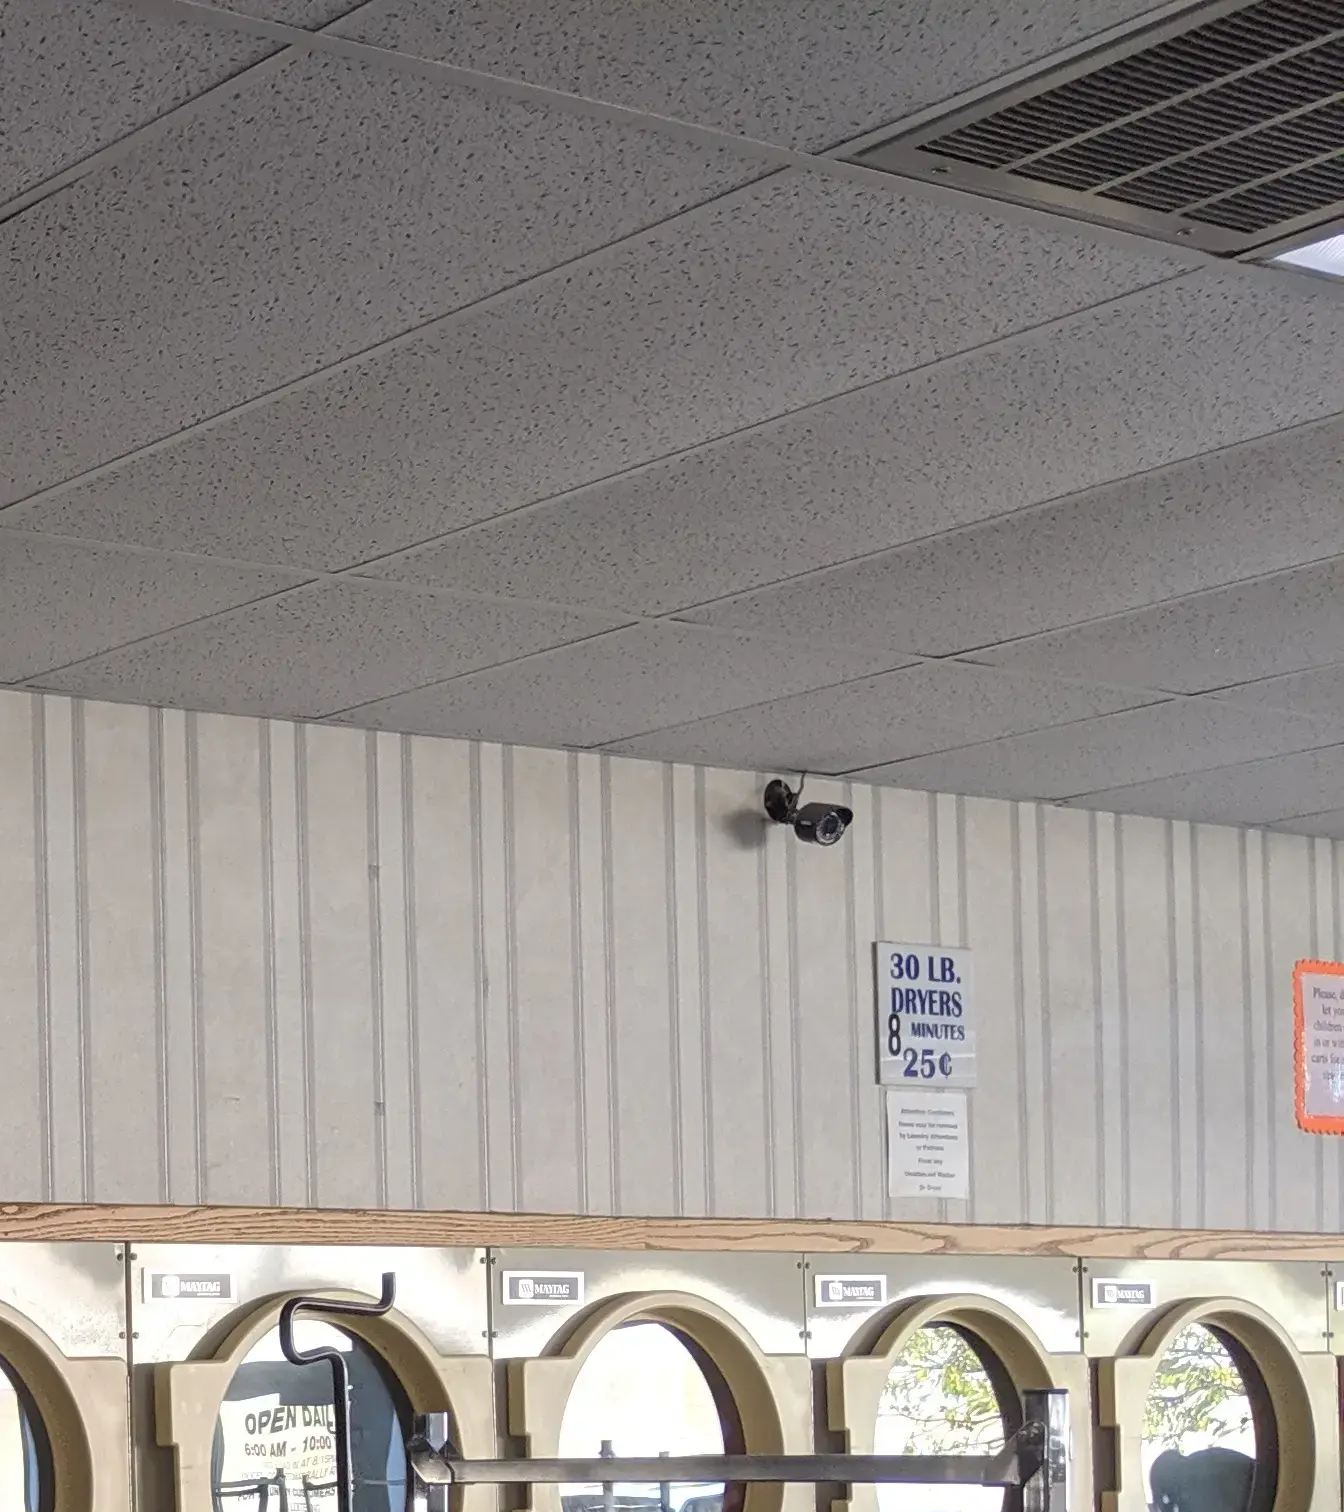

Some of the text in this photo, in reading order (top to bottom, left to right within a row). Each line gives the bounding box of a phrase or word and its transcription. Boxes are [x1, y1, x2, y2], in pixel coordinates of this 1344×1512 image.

[890, 953, 961, 984] 30 LB.
[891, 988, 962, 1018] DRYERS
[888, 1013, 965, 1056] 8 MINUTES
[180, 1280, 221, 1294] MAYTAG
[534, 1282, 570, 1295] MAYTAG
[245, 1405, 336, 1434] OPEN DAIL
[244, 1443, 266, 1456] 6:00
[270, 1441, 287, 1457] AM
[303, 1436, 332, 1453] 10:00
